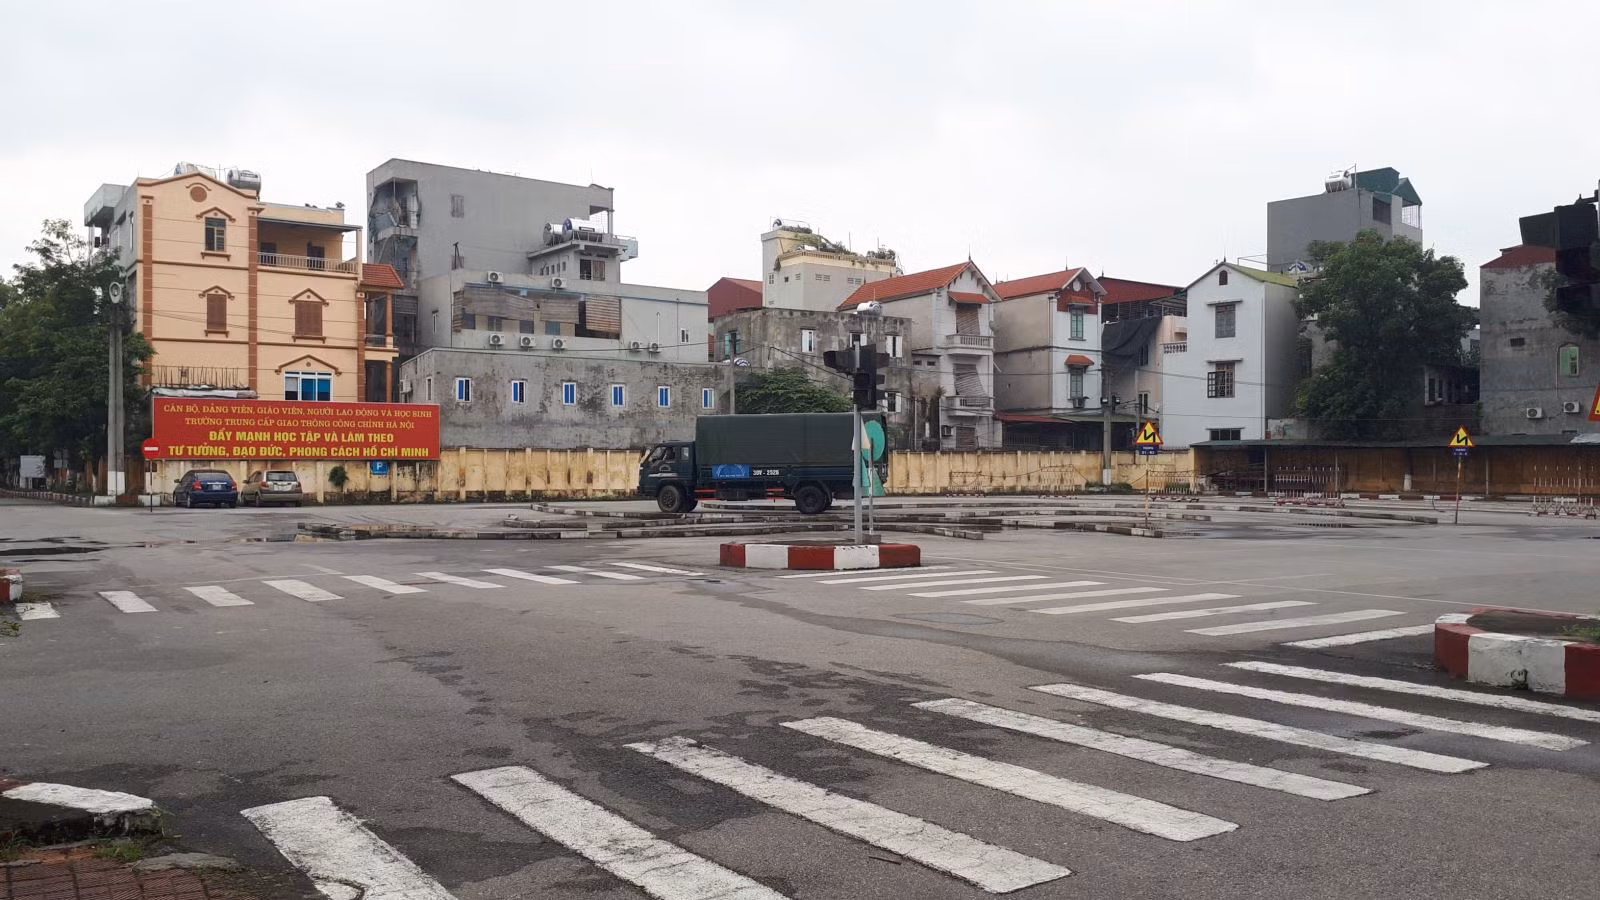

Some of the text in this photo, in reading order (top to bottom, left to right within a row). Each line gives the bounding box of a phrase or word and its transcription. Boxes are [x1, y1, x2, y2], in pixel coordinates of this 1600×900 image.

[336, 408, 354, 416] LAO
[394, 410, 412, 418] HỌC
[224, 418, 256, 426] TRUNG
[236, 432, 271, 443] MẠNH
[274, 432, 296, 444] HỌC
[300, 430, 321, 444] TẬP
[324, 430, 339, 442] VÀ
[368, 433, 394, 443] THEO
[168, 445, 184, 456] TƯ
[232, 446, 257, 458] ĐẠO
[289, 447, 328, 457] PHONG
[401, 448, 430, 457] MINH
[376, 462, 382, 470] P
